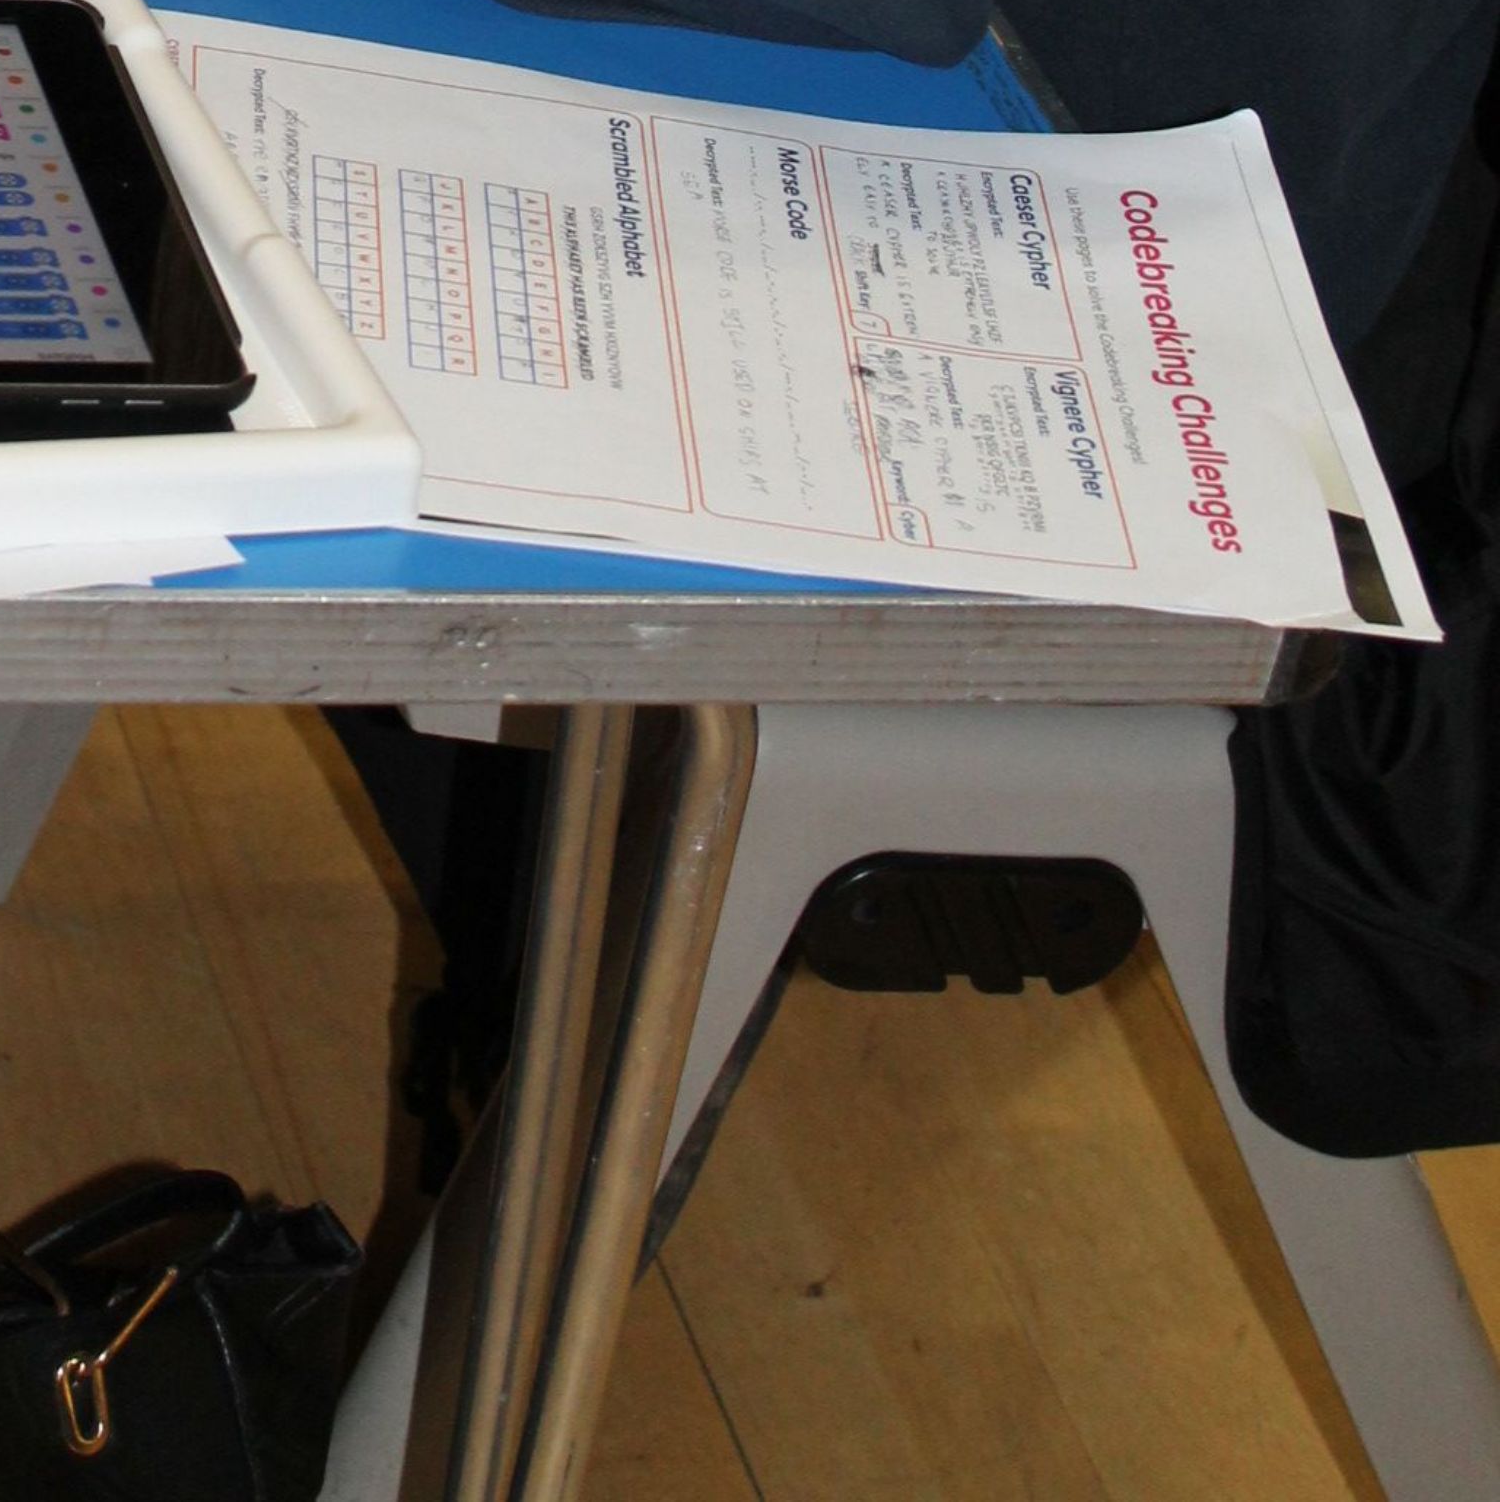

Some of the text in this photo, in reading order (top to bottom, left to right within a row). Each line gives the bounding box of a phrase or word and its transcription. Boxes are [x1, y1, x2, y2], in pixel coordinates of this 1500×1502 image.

[251, 68, 266, 133] Decrypted Text:
[609, 118, 645, 276] Scrambled Alphabet
[704, 138, 723, 207] Decrypted Text:
[777, 147, 811, 239] Morse Code
[900, 162, 921, 230] Decrypted Text:
[980, 171, 1003, 237] Encrypted Text:
[1009, 174, 1050, 289] Caeser Cypher
[1064, 187, 1147, 464] Use these pages to solve the Codebreaking Challenges!
[938, 355, 963, 429] Decrypted Text:
[1023, 366, 1049, 436] Encrypted Text:
[1121, 191, 1240, 551] Codebreaking Challenges
[1050, 371, 1102, 498] Vignere Cypher
